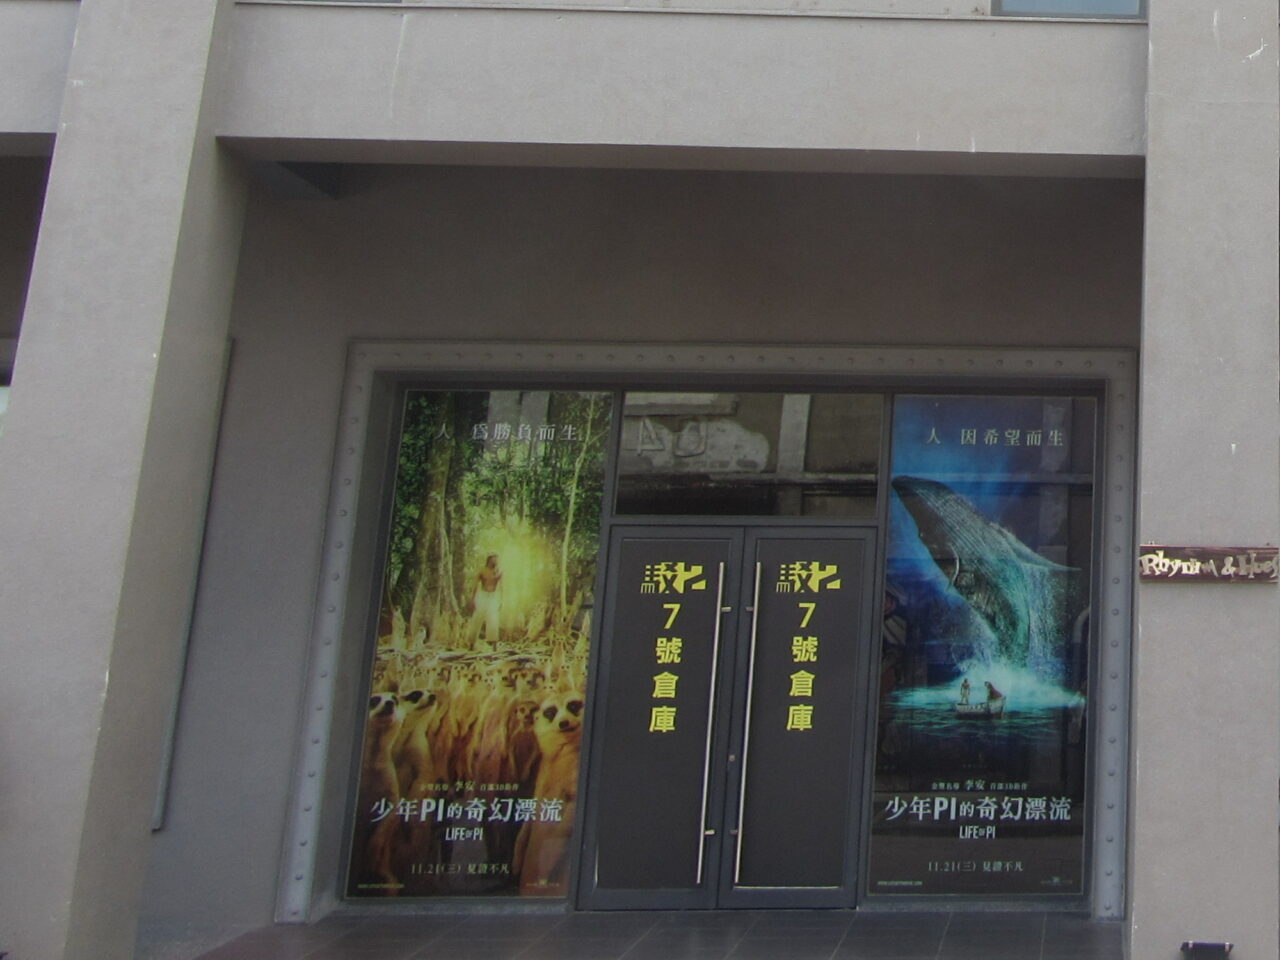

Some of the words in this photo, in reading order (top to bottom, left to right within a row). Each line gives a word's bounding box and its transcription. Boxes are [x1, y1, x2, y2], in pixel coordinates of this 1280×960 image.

[960, 428, 1065, 447] 因希望而生
[1221, 556, 1236, 577] &
[648, 603, 684, 733] 7號倉庫
[786, 602, 819, 732] 7號倉庫
[370, 797, 565, 822] 少年PI的奇幻漂流
[885, 796, 1072, 822] 少年PI的奇幻漂流
[445, 827, 466, 841] LIFE
[473, 827, 483, 841] PI
[959, 825, 979, 839] LIFE
[986, 825, 996, 839] PI
